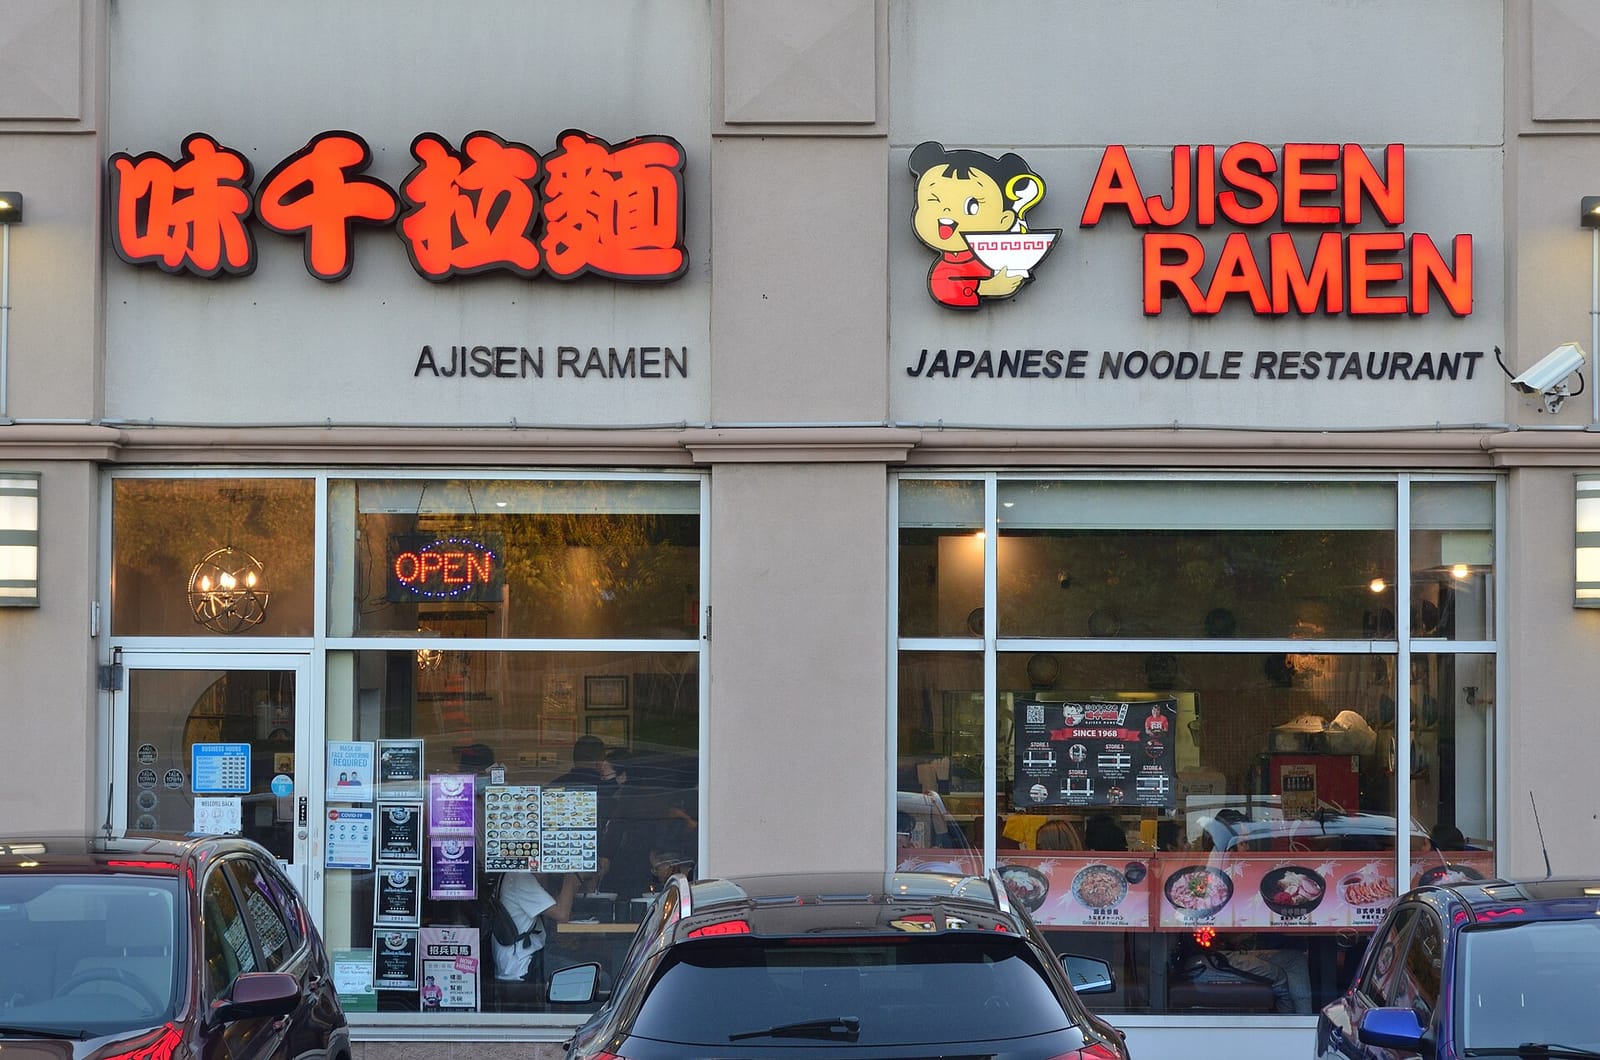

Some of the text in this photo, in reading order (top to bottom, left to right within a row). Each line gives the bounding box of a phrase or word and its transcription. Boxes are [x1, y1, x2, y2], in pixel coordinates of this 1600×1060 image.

[1080, 141, 1405, 227] AJISEN
[1142, 232, 1473, 316] RAMEN
[414, 346, 688, 378] AJISEN RAMEN
[907, 349, 1483, 381] JAPANESE NOODLE RESTAURANT
[395, 552, 492, 584] OPEN
[1098, 730, 1117, 738] 1968
[333, 759, 368, 767] REQUIRED
[429, 945, 469, 955] 招兵買馬
[456, 963, 476, 971] HIRING
